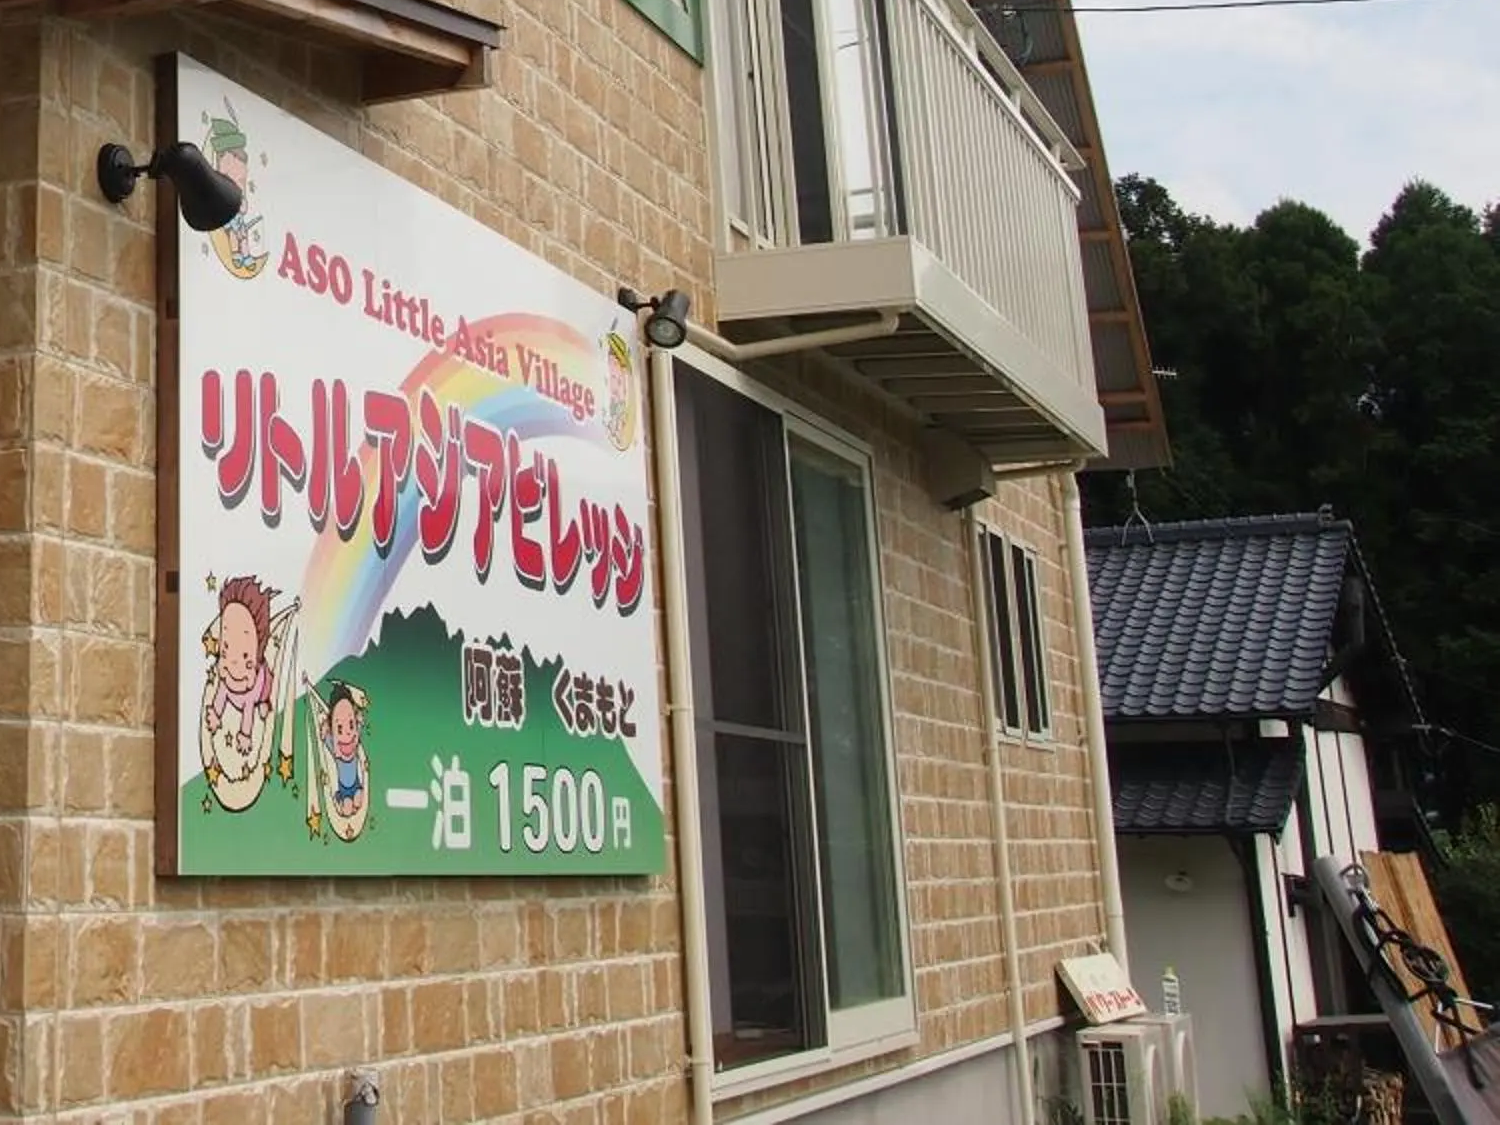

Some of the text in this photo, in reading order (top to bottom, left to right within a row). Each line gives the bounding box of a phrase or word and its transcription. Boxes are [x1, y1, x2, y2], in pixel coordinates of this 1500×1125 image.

[277, 231, 595, 421] ASO Little Asia Village
[201, 369, 644, 615] リトルアジアビレッジ
[463, 646, 637, 738] 阿蘇 くまもと
[386, 754, 471, 850] 一泊
